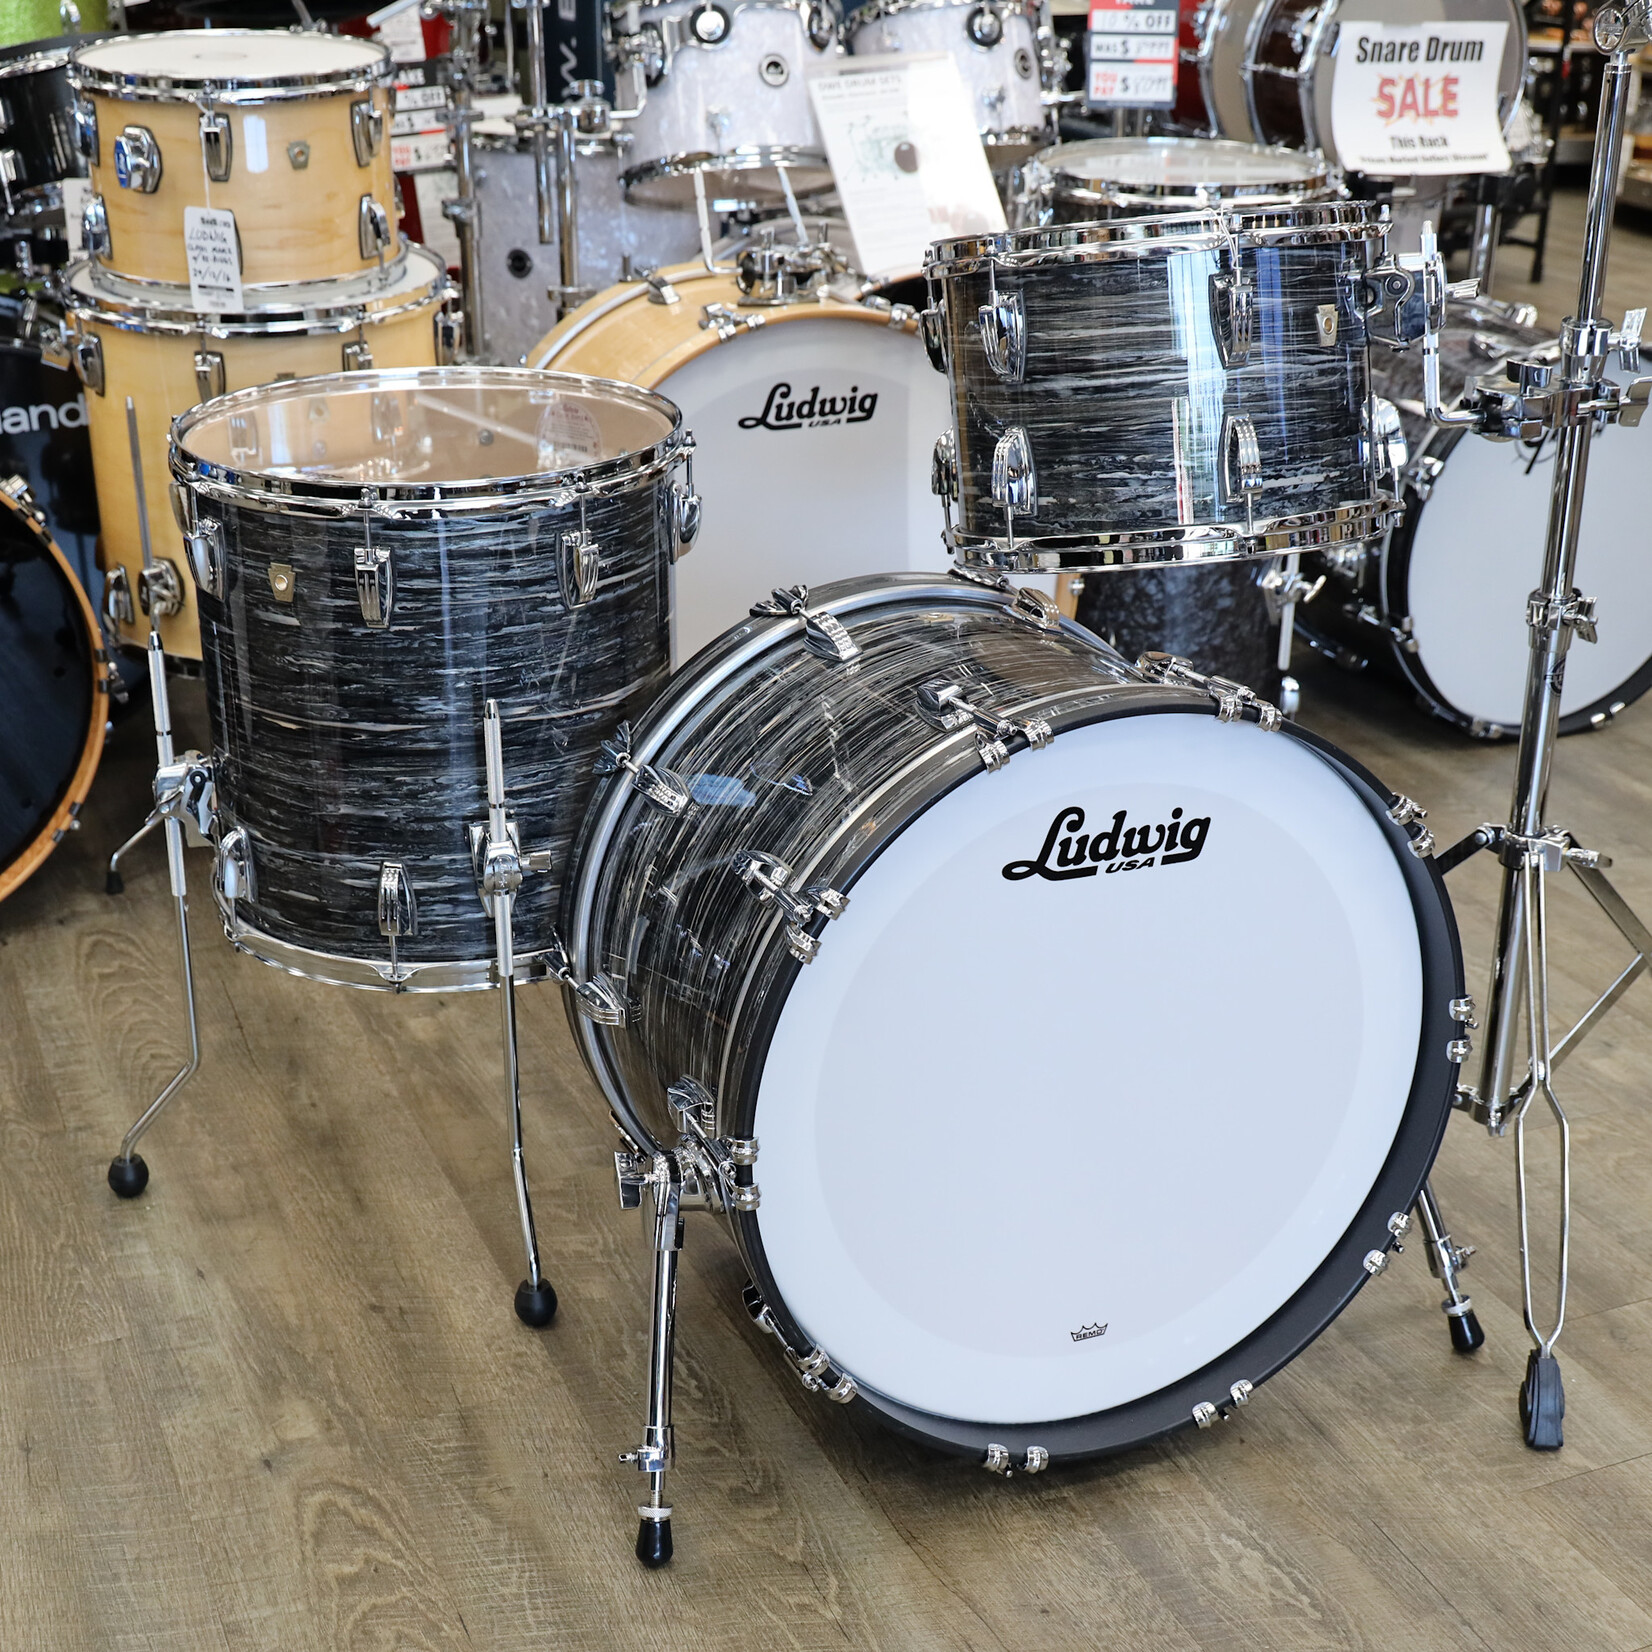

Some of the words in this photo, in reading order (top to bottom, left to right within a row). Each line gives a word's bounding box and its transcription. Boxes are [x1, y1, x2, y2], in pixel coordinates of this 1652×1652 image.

[1145, 14, 1171, 29] OFF
[1095, 43, 1118, 54] WAS
[1121, 39, 1130, 56] $
[1356, 36, 1420, 64] Snare
[1425, 36, 1484, 62] Drum
[1094, 86, 1115, 96] PAY
[1121, 76, 1130, 94] $
[1095, 72, 1118, 84] YOU
[421, 91, 442, 103] OFF
[1375, 76, 1459, 119] SALE
[1389, 135, 1416, 149] This
[1418, 134, 1449, 148] Rack
[738, 382, 879, 430] Ludwig
[808, 417, 842, 428] USA
[1001, 806, 1212, 882] Ludwig
[1104, 856, 1156, 874] USA
[1076, 1328, 1106, 1339] REMO
